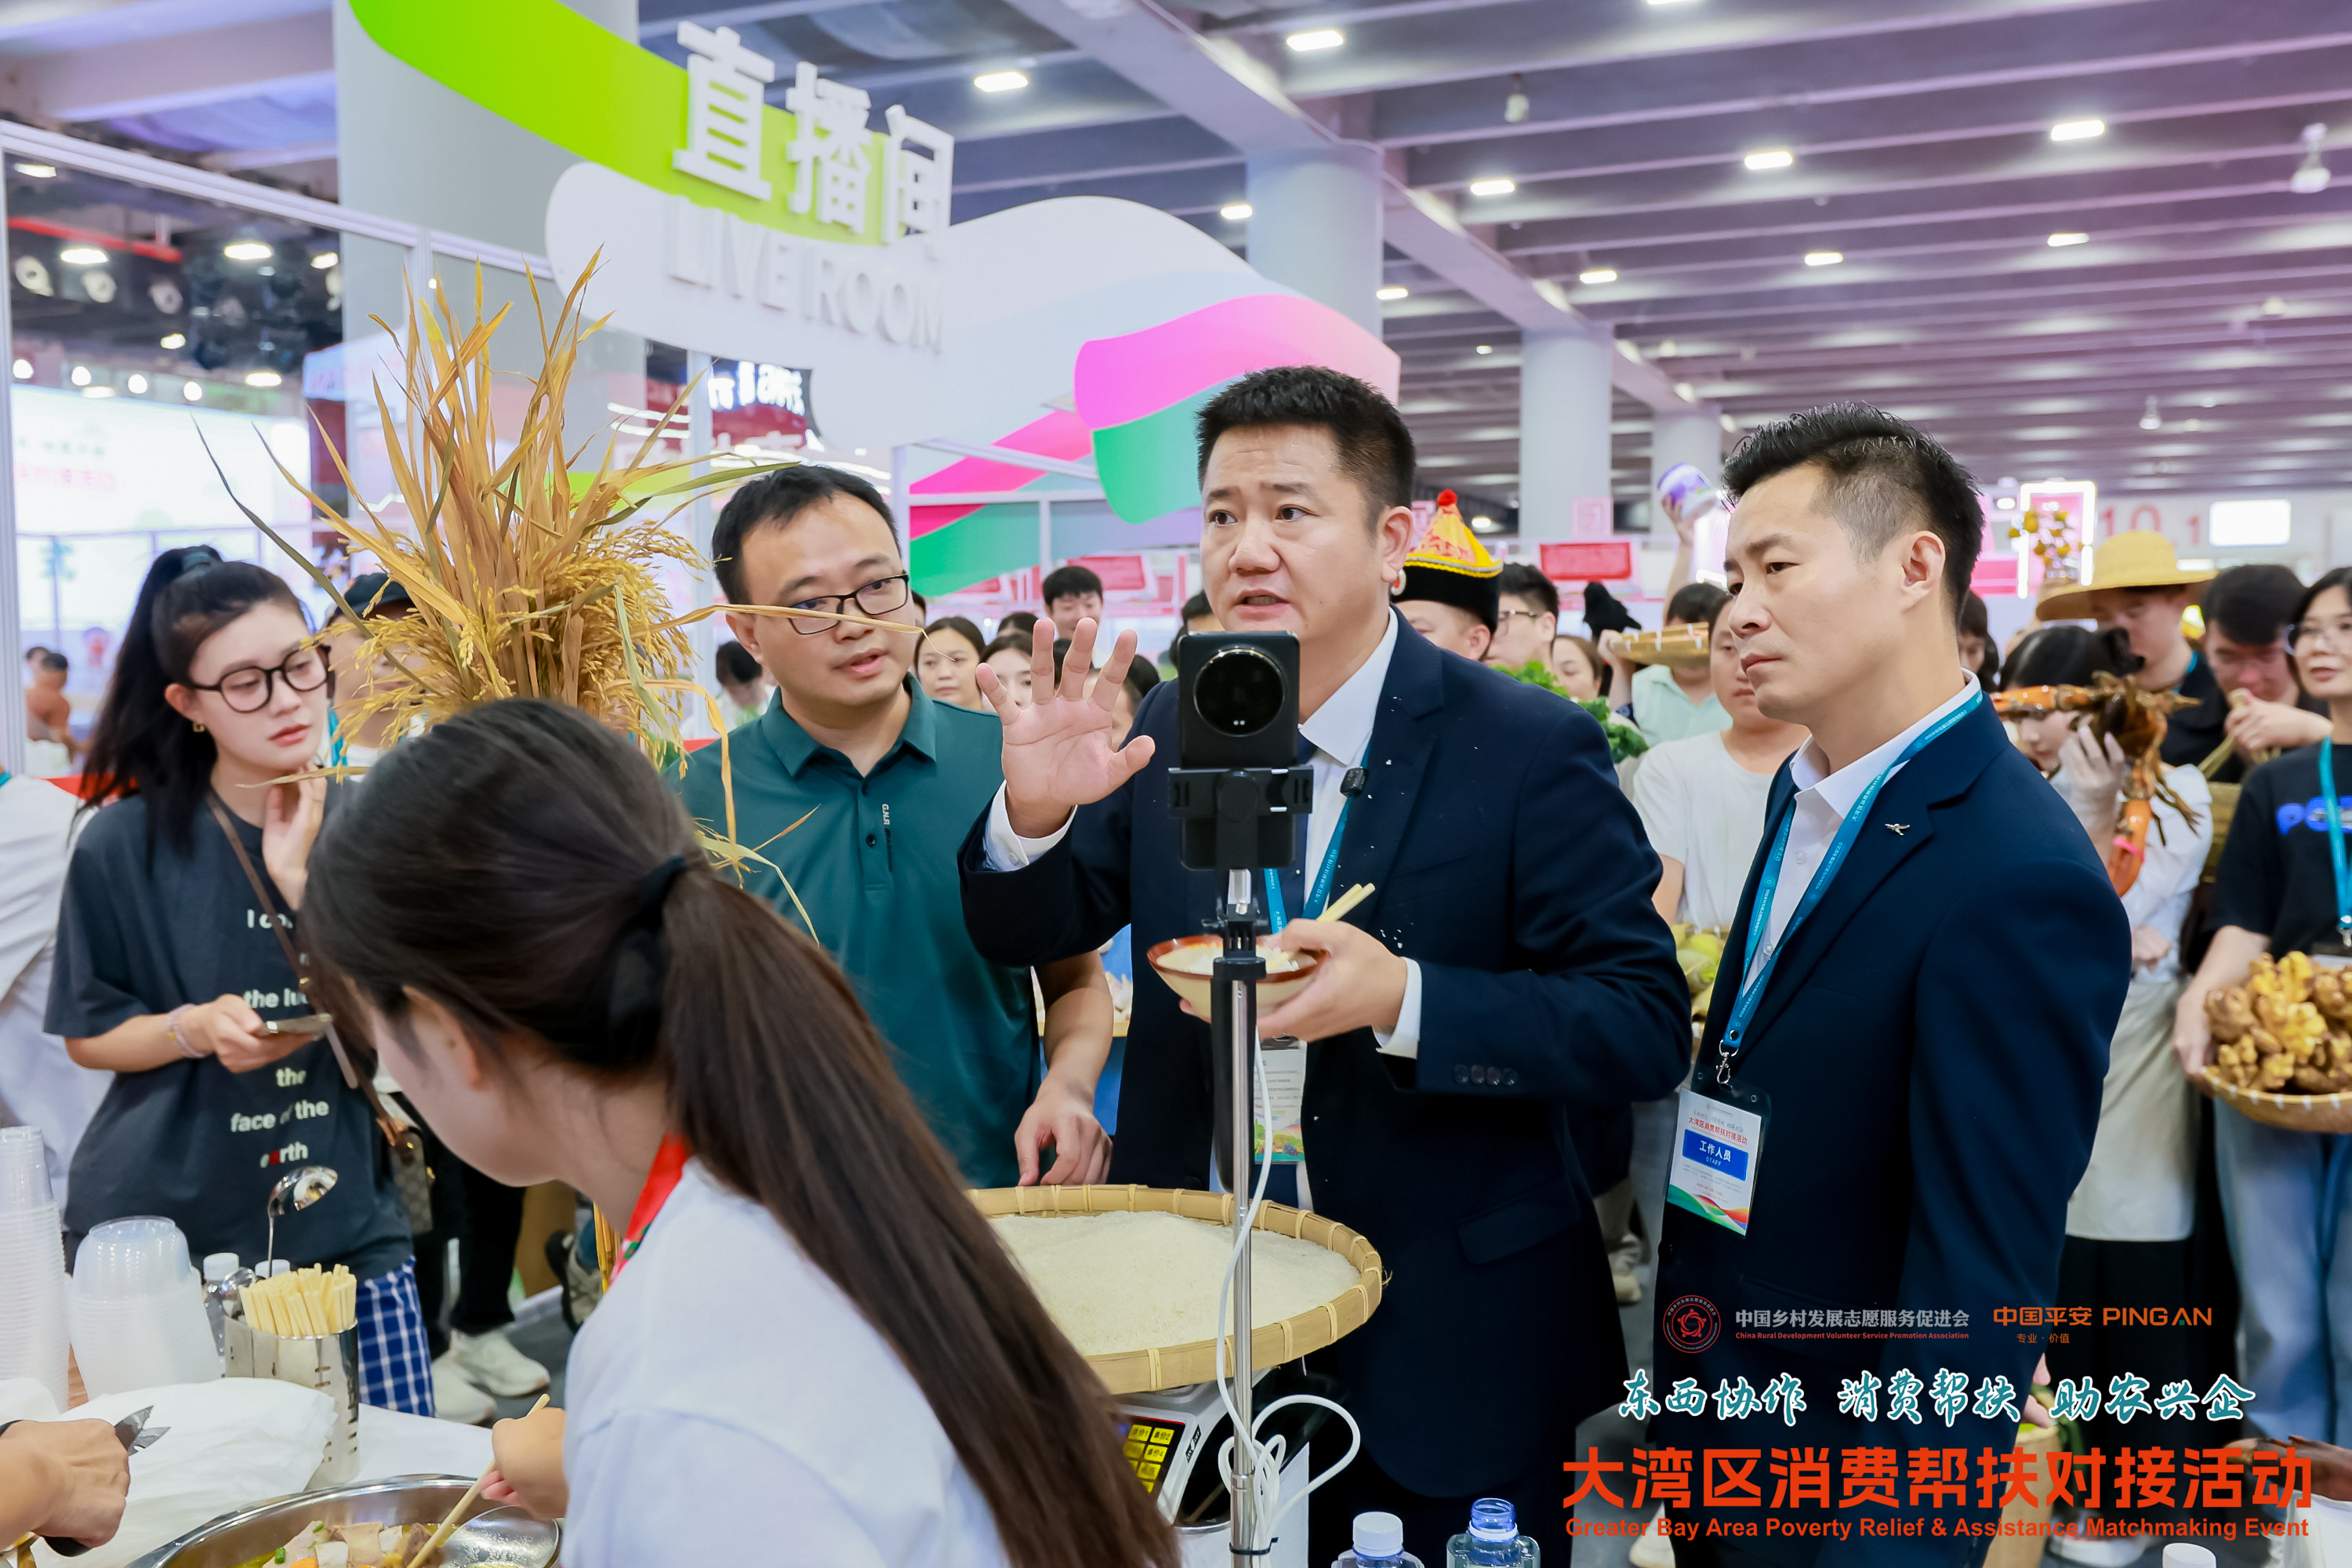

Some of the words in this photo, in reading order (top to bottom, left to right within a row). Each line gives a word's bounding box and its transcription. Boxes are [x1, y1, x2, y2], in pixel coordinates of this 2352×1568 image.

[673, 20, 954, 245] 直播间
[662, 192, 792, 314] LIVE
[795, 235, 944, 355] ROOM
[246, 908, 256, 929] I
[242, 988, 280, 1009] the
[230, 1112, 277, 1133] face
[294, 1098, 330, 1120] the
[260, 1141, 309, 1168] erth
[1699, 1139, 1732, 1163] 工作人员
[1705, 1156, 1722, 1167] STAFF
